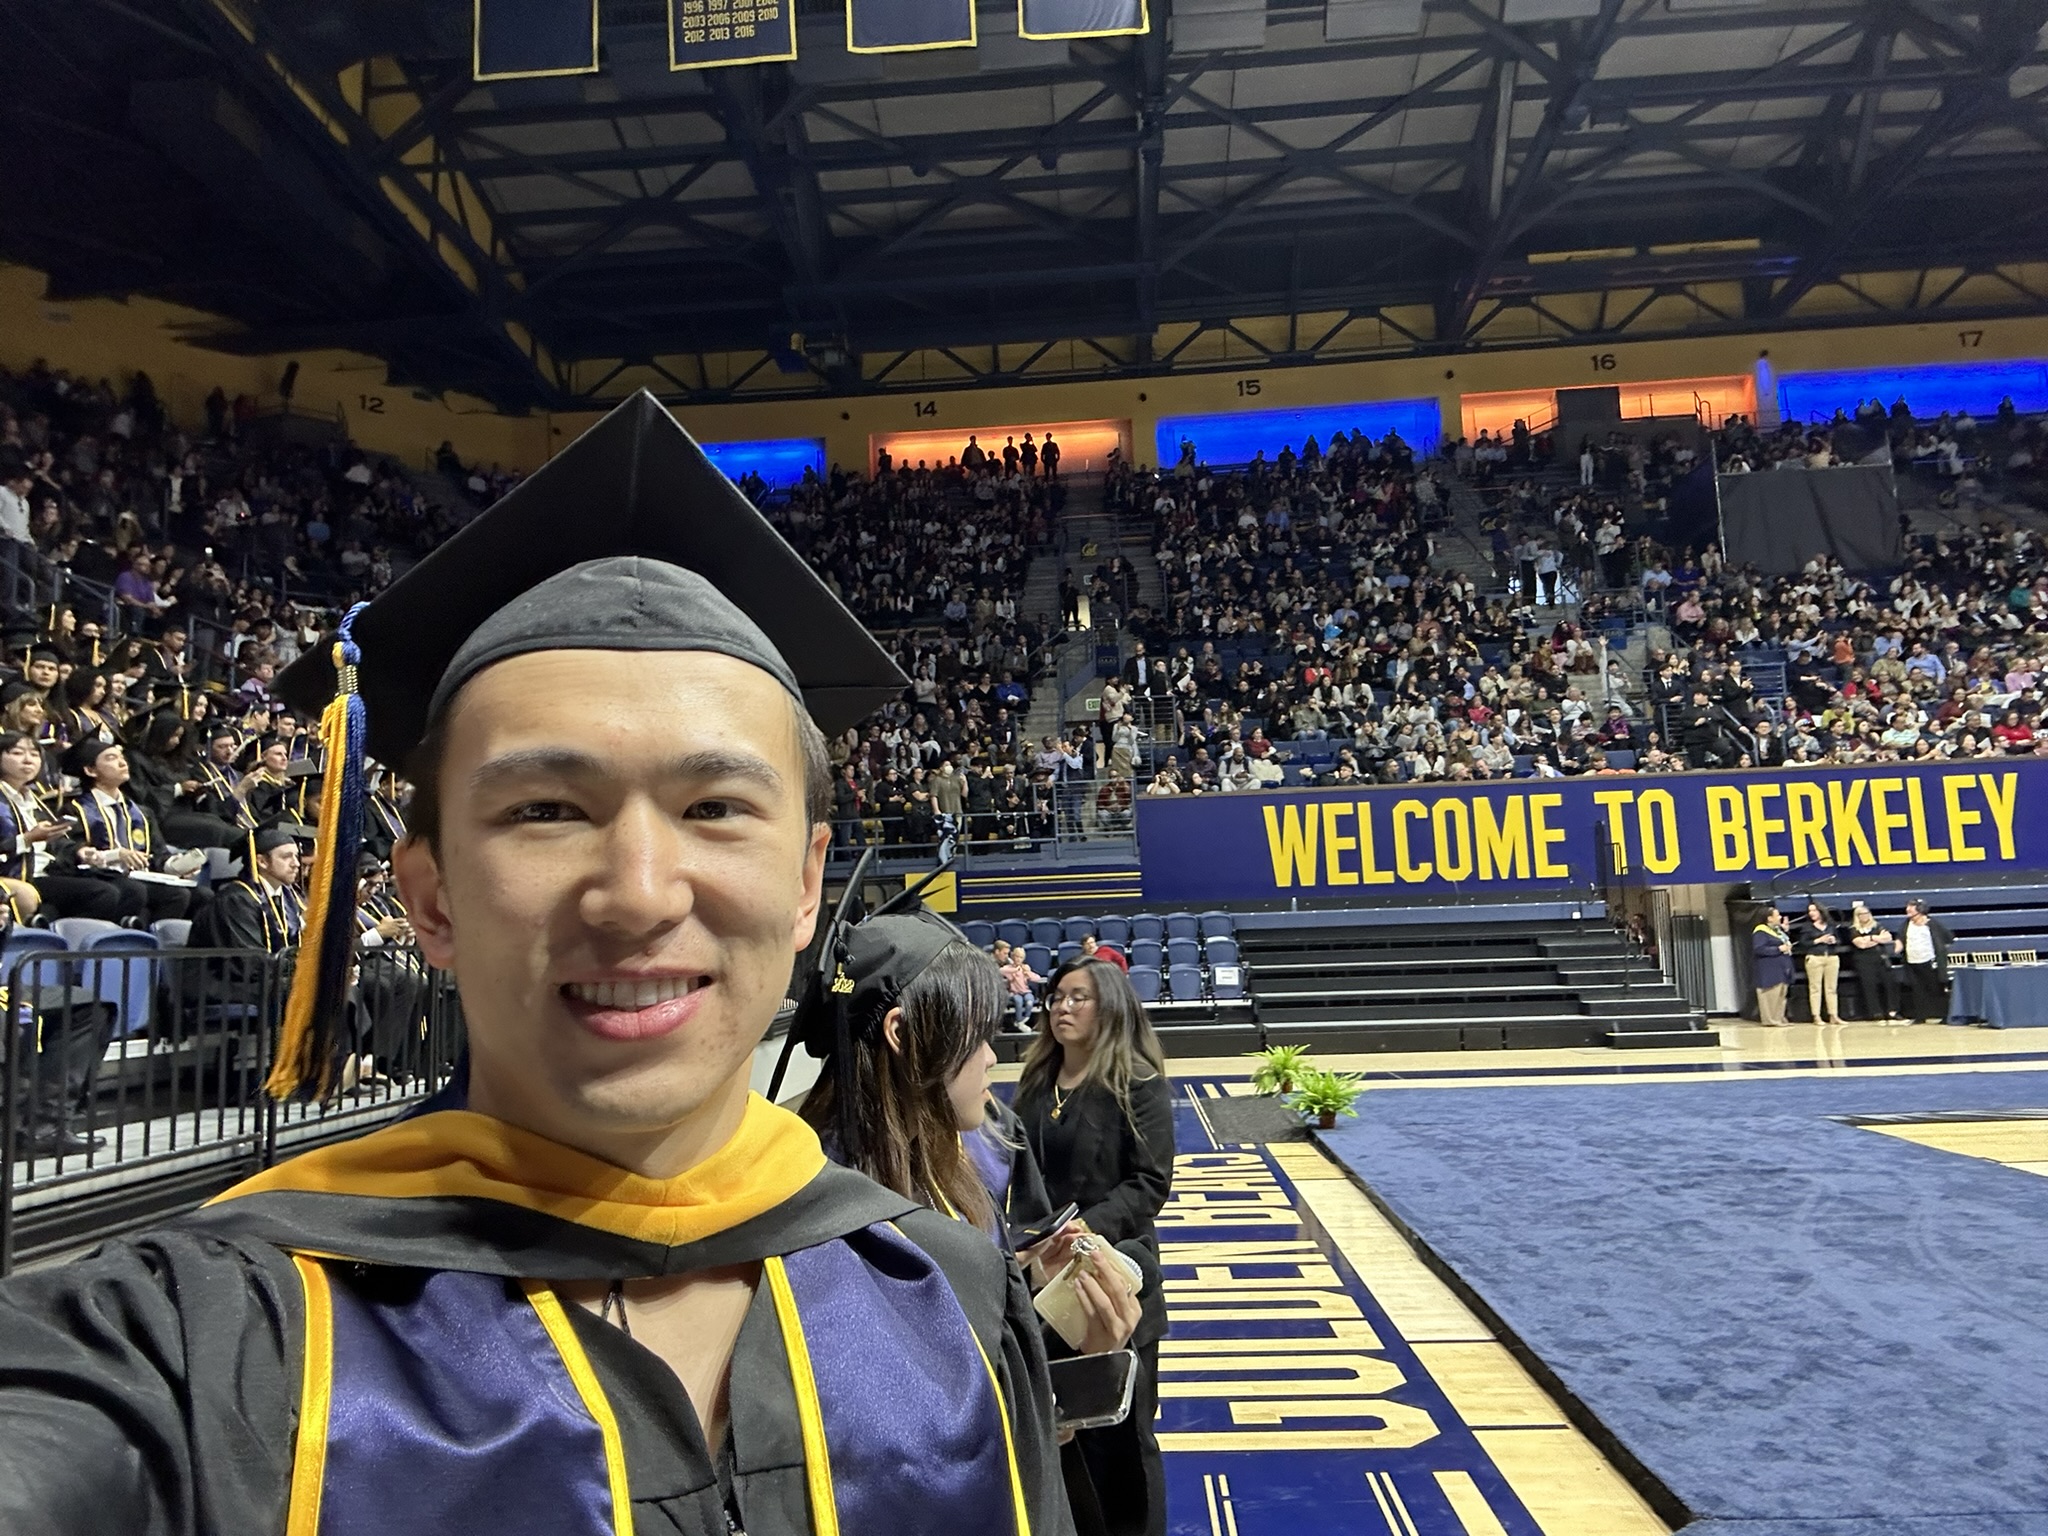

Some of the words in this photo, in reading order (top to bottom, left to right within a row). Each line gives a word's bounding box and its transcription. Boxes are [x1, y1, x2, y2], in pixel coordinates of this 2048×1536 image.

[683, 0, 704, 14] 1996
[682, 15, 706, 29] 2003
[707, 13, 730, 26] 2006
[732, 10, 755, 23] 2009
[757, 7, 779, 20] 2010
[684, 30, 705, 43] 2012
[709, 27, 730, 40] 2013
[734, 25, 755, 38] 2016
[1958, 330, 1983, 347] 17
[1591, 353, 1616, 371] 16
[1237, 379, 1261, 397] 15
[359, 394, 384, 414] 12
[914, 400, 937, 417] 14
[1262, 793, 1570, 888] WELCOME
[1593, 788, 1681, 876] TO
[1705, 772, 2018, 872] BERKELEY
